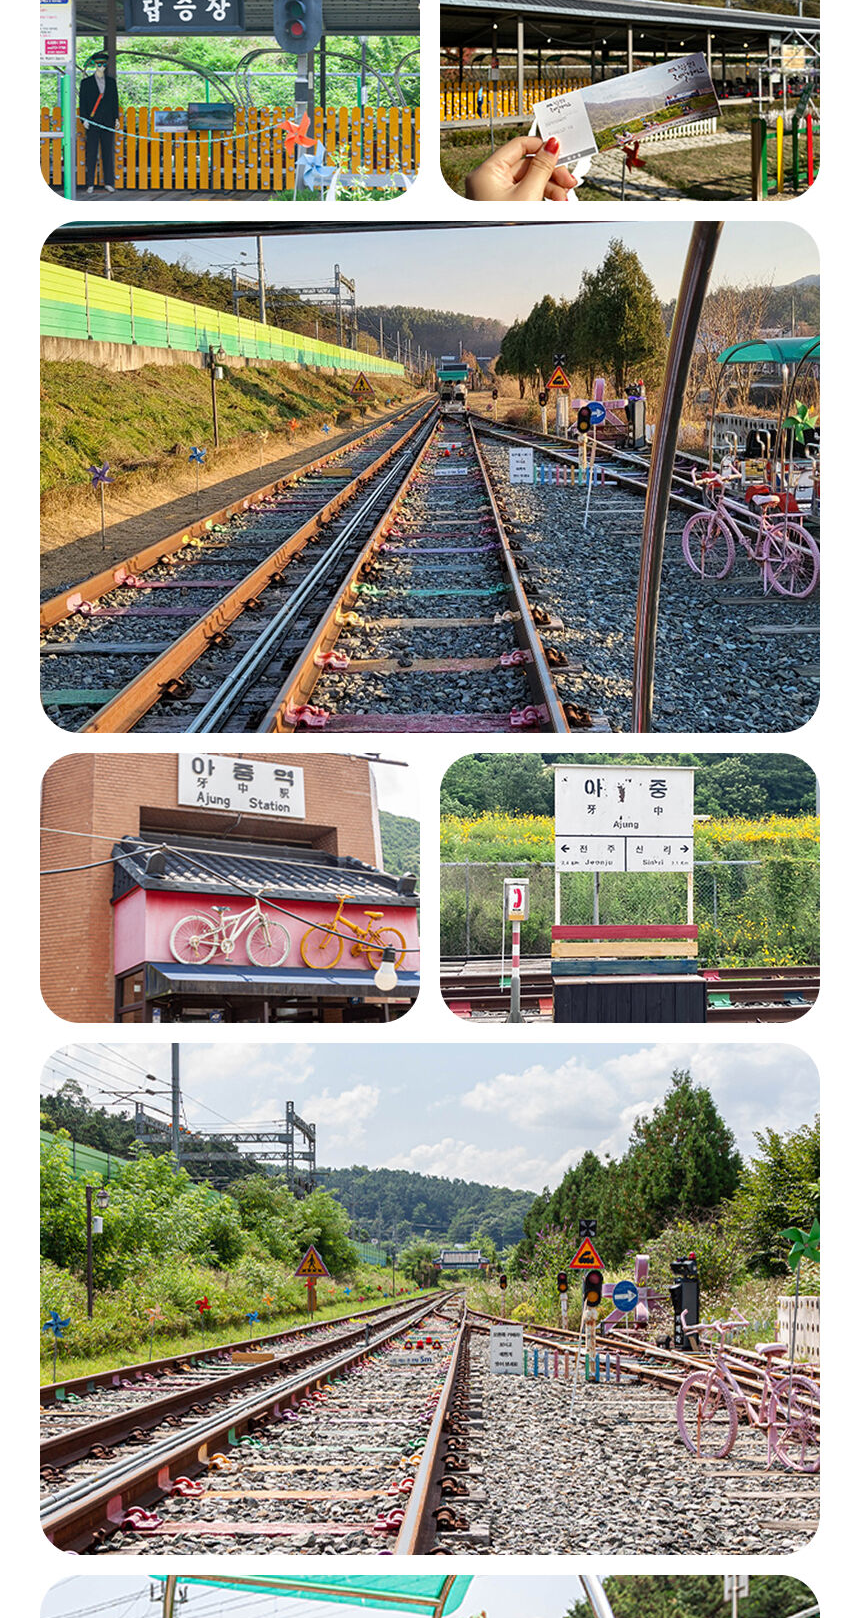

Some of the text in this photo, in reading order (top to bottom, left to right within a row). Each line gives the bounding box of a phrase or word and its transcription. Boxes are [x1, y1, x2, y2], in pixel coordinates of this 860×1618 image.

[197, 792, 290, 813] Ajung Station
[613, 821, 639, 829] Ajung
